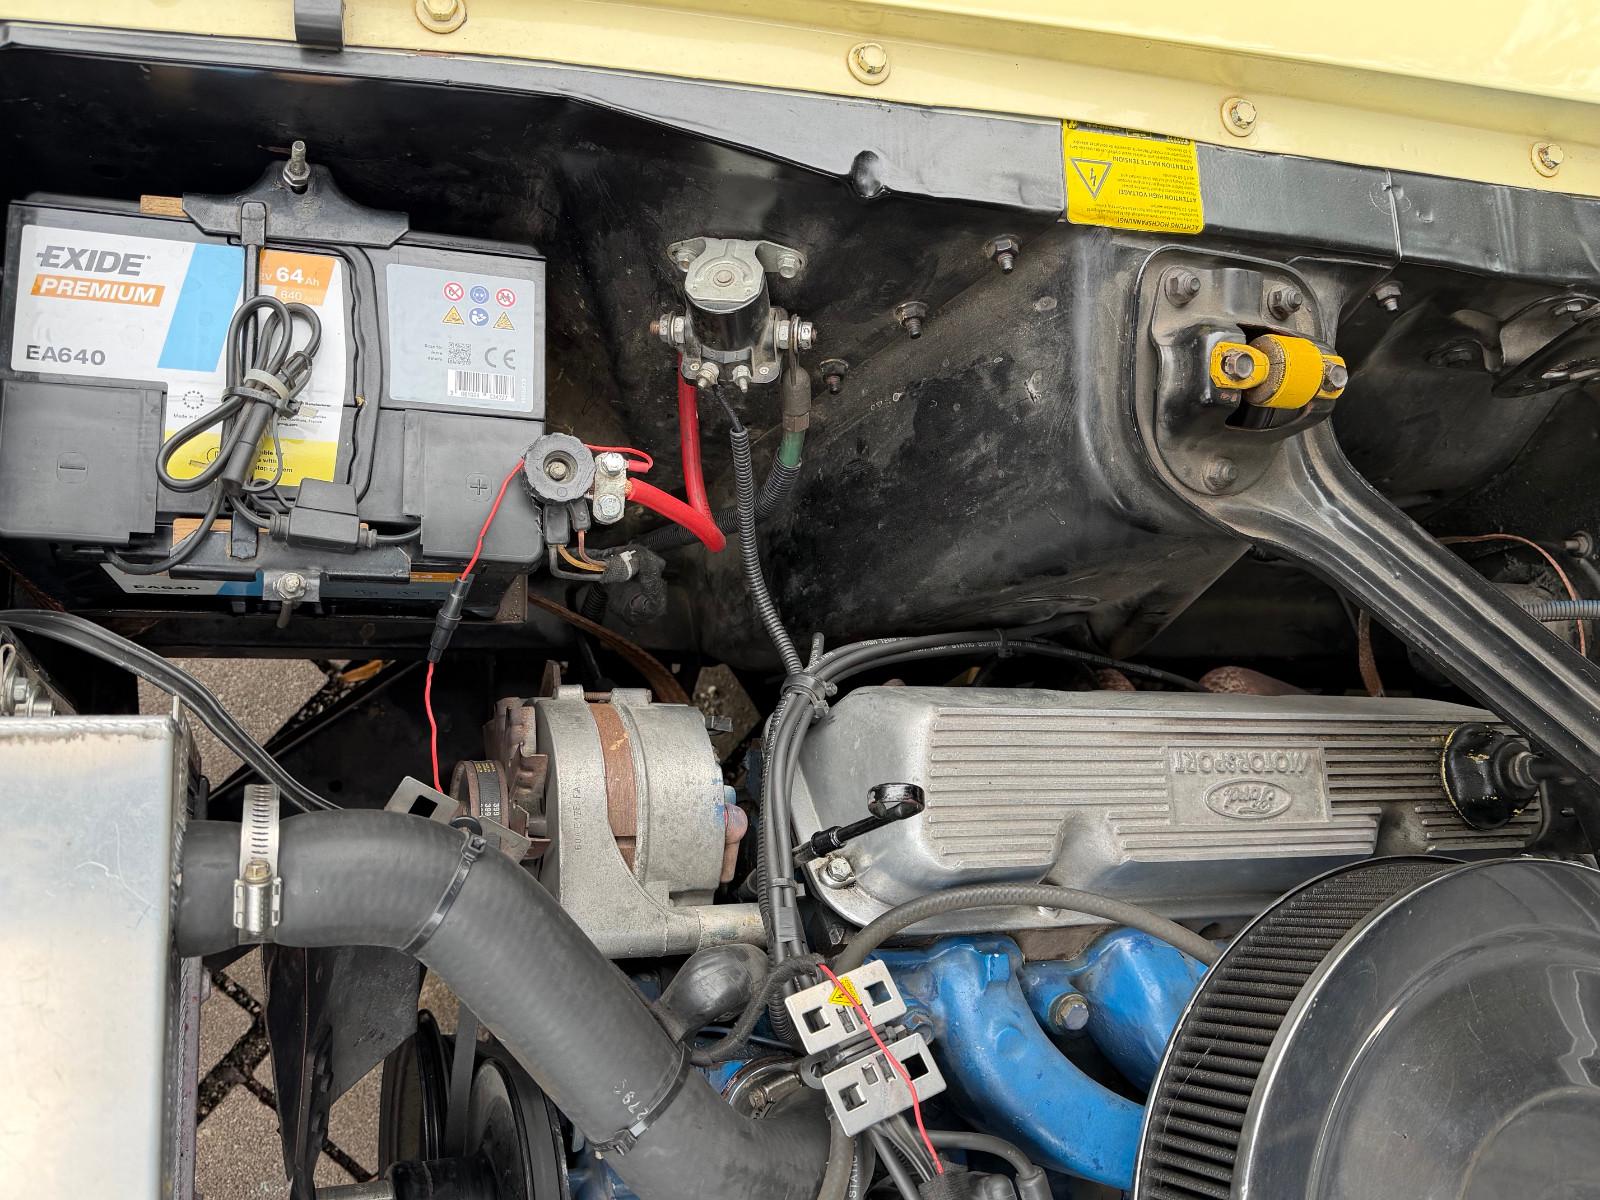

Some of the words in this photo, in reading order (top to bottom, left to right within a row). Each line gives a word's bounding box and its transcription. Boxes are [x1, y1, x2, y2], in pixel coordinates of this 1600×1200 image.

[1112, 156, 1139, 165] TENSION!
[1140, 159, 1161, 168] HAUTE
[1161, 161, 1194, 171] ATTENTION
[1118, 189, 1147, 198] VOLTAGE!
[1147, 191, 1164, 200] HIGH
[1164, 193, 1197, 203] ATTENTION
[1117, 217, 1170, 228] HOCHSPANNUNG!
[1170, 221, 1200, 231] ACHTUNG
[36, 245, 146, 276] EXIDE
[276, 266, 304, 284] 64
[304, 277, 320, 286] Ah
[40, 278, 156, 304] PREMIUM
[26, 344, 106, 366] EA640
[1174, 751, 1308, 775] MOTORSPORT
[1223, 787, 1275, 816] Ford
